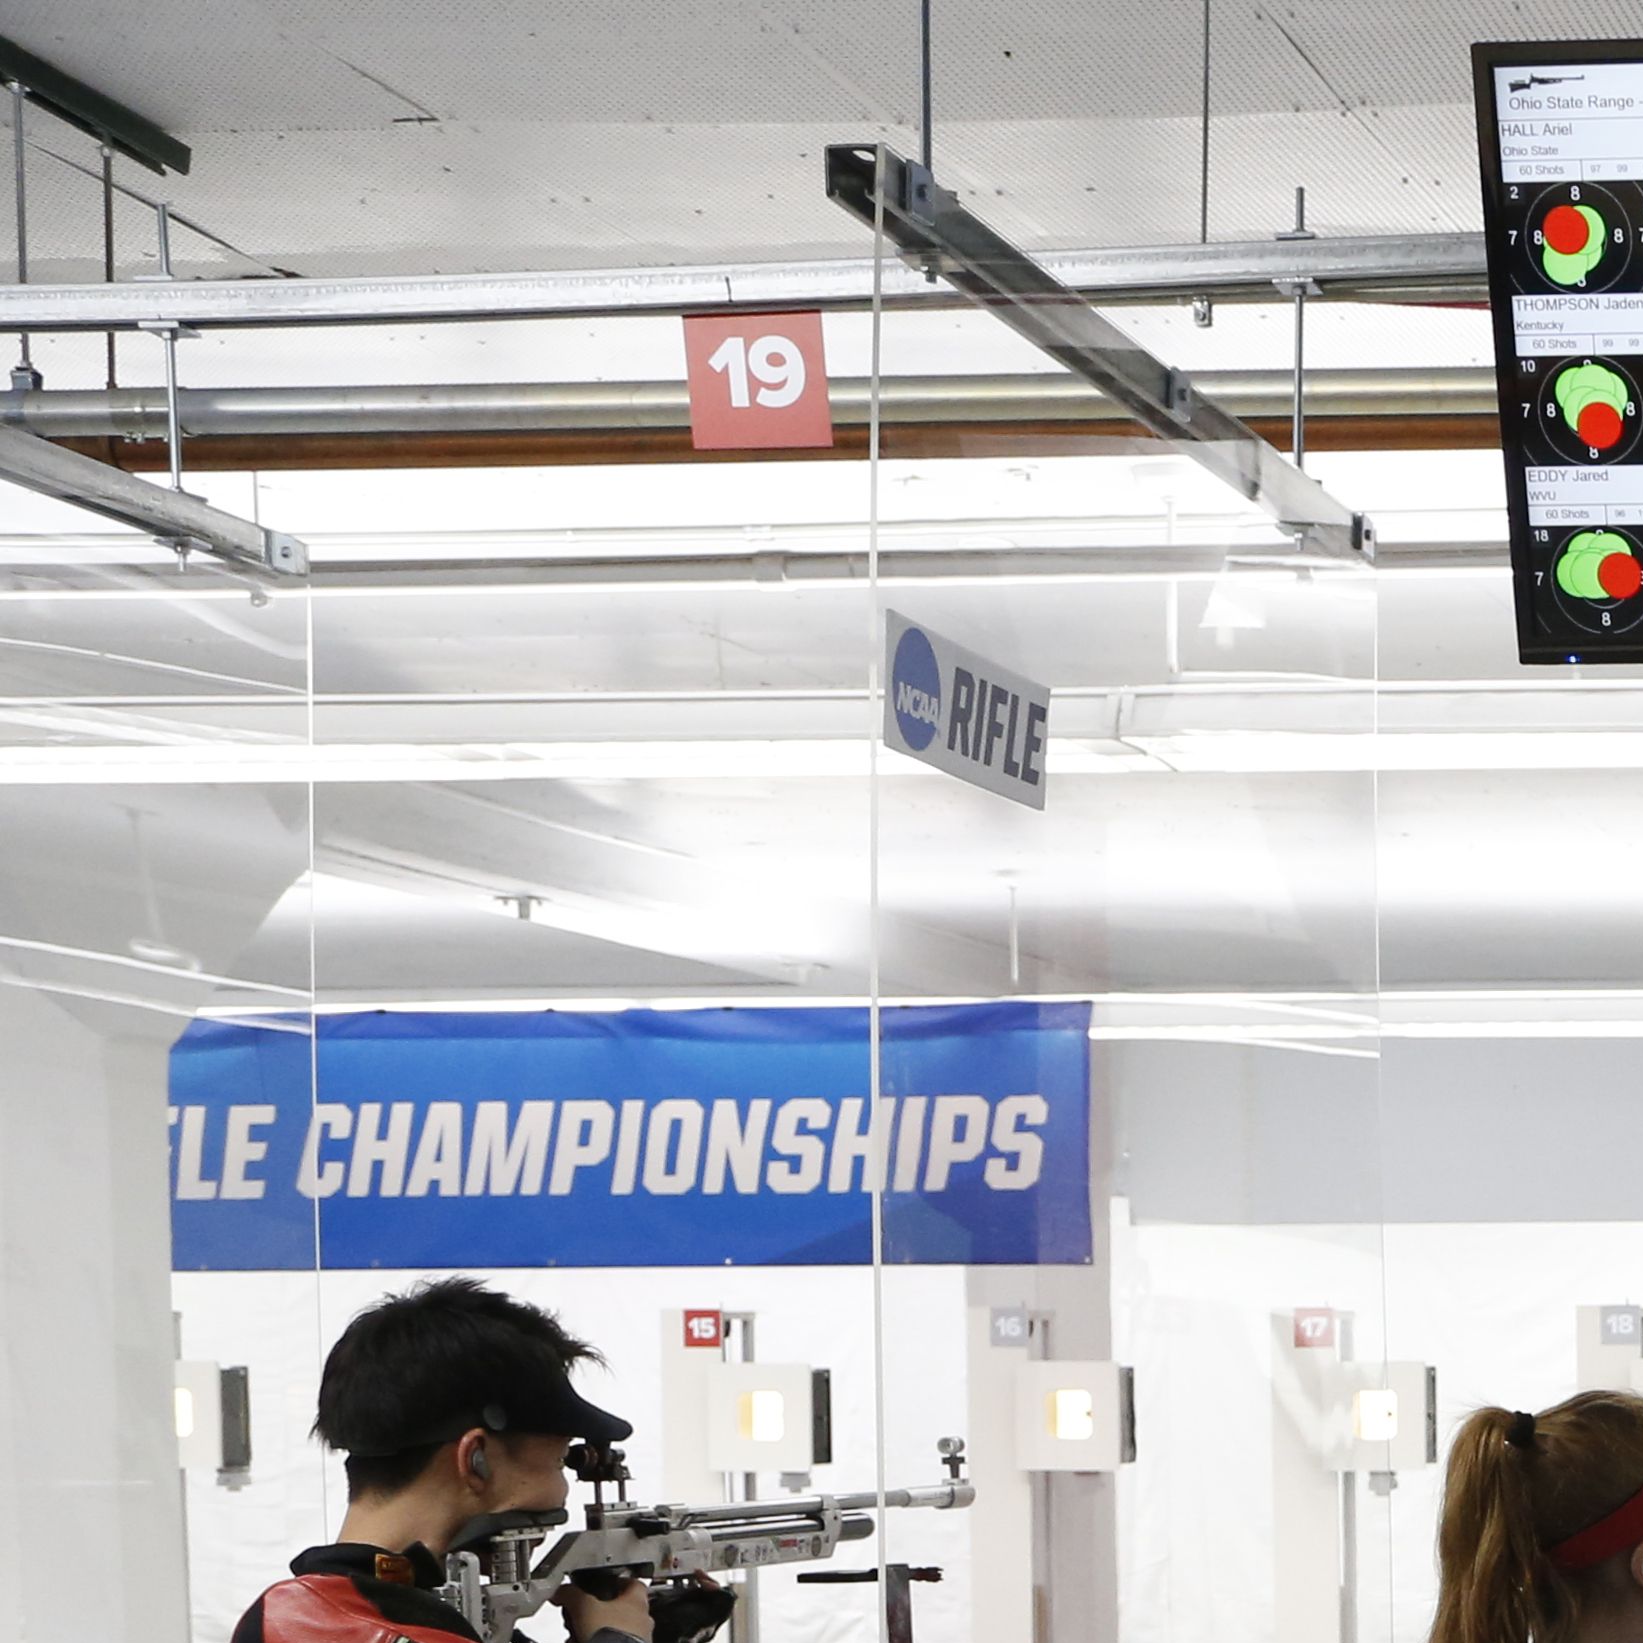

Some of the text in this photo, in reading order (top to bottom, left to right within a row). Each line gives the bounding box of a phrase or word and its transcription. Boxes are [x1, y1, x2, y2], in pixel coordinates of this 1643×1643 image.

[1509, 97, 1543, 110] Ohio
[1547, 96, 1584, 109] State
[1588, 94, 1634, 110] Range
[1502, 122, 1573, 136] HALL Ariel
[1503, 145, 1558, 156] Ohio State
[1516, 297, 1600, 312] THOMPSON
[1516, 319, 1564, 332] Kentucky
[708, 335, 806, 408] 19
[1528, 468, 1608, 482] EDDY Jared
[1529, 490, 1556, 501] WVU
[897, 666, 1047, 785] NCAA RIFLE
[168, 1090, 1048, 1200] LE CHAMPIONSHIPS
[688, 1317, 716, 1338] 15
[995, 1317, 1021, 1337] 16
[1301, 1316, 1328, 1338] 17
[1607, 1314, 1634, 1334] 18
